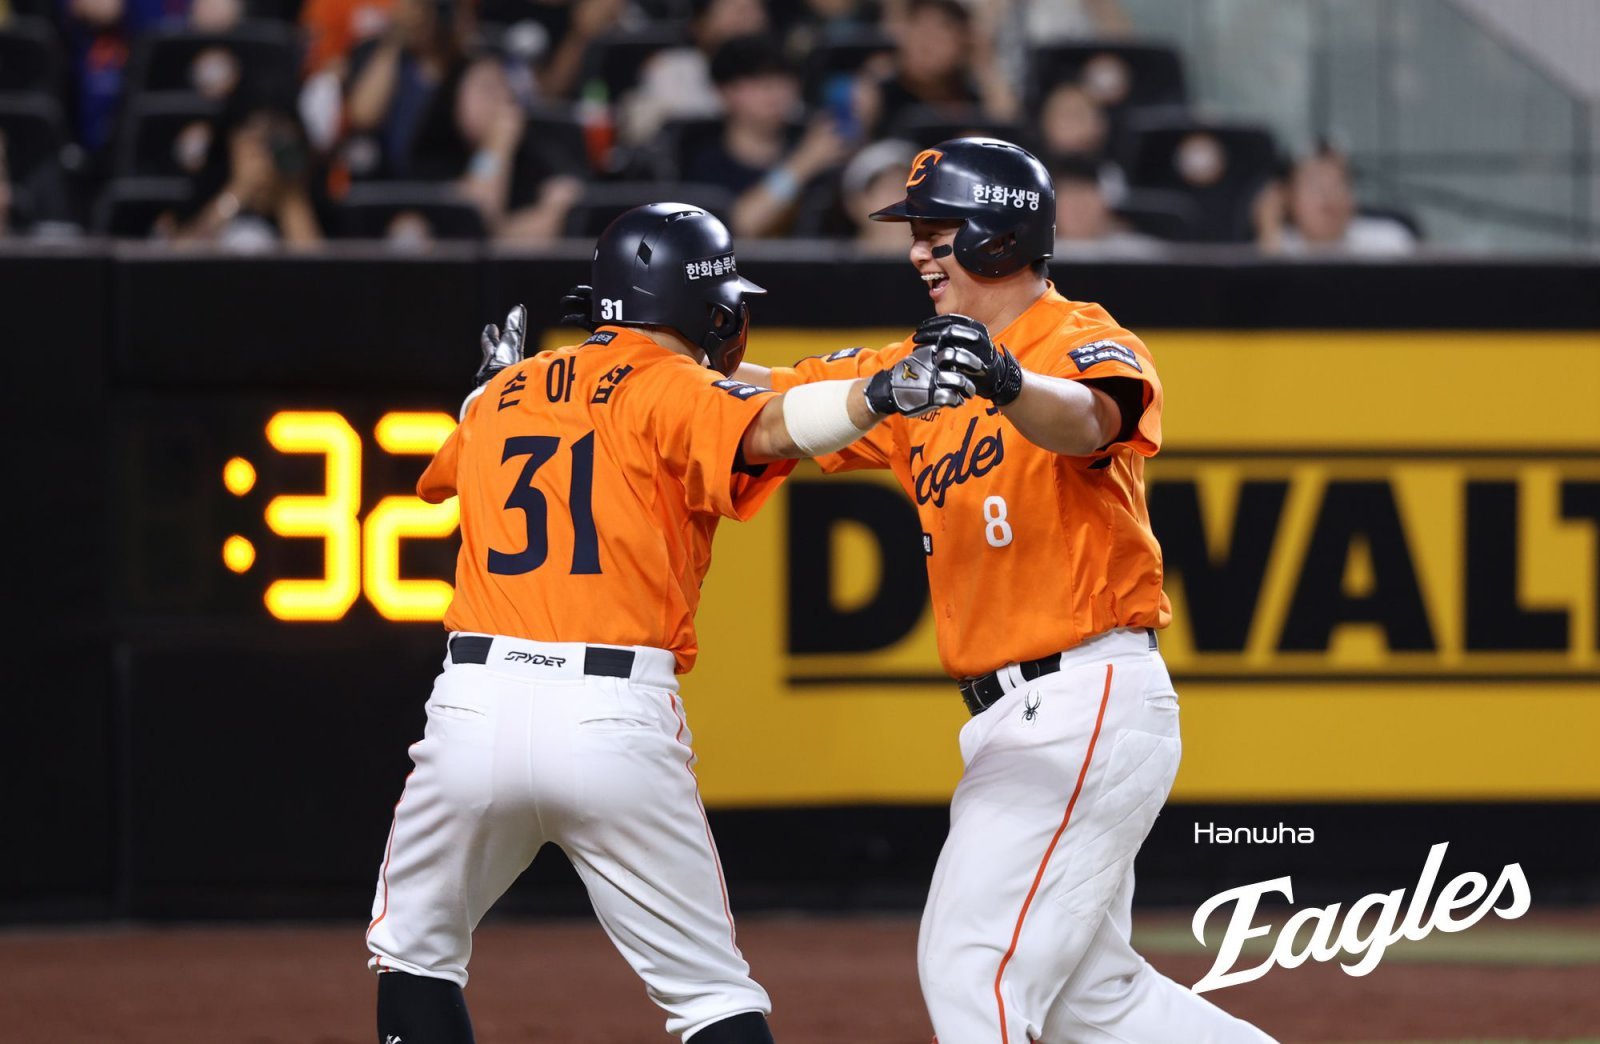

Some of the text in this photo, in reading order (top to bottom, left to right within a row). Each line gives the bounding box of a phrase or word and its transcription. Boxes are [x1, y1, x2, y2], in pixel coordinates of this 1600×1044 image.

[973, 184, 1040, 211] 한화생명
[601, 298, 623, 321] 31
[487, 429, 603, 576] 31
[983, 495, 1013, 548] 8
[504, 650, 567, 669] SPYDER
